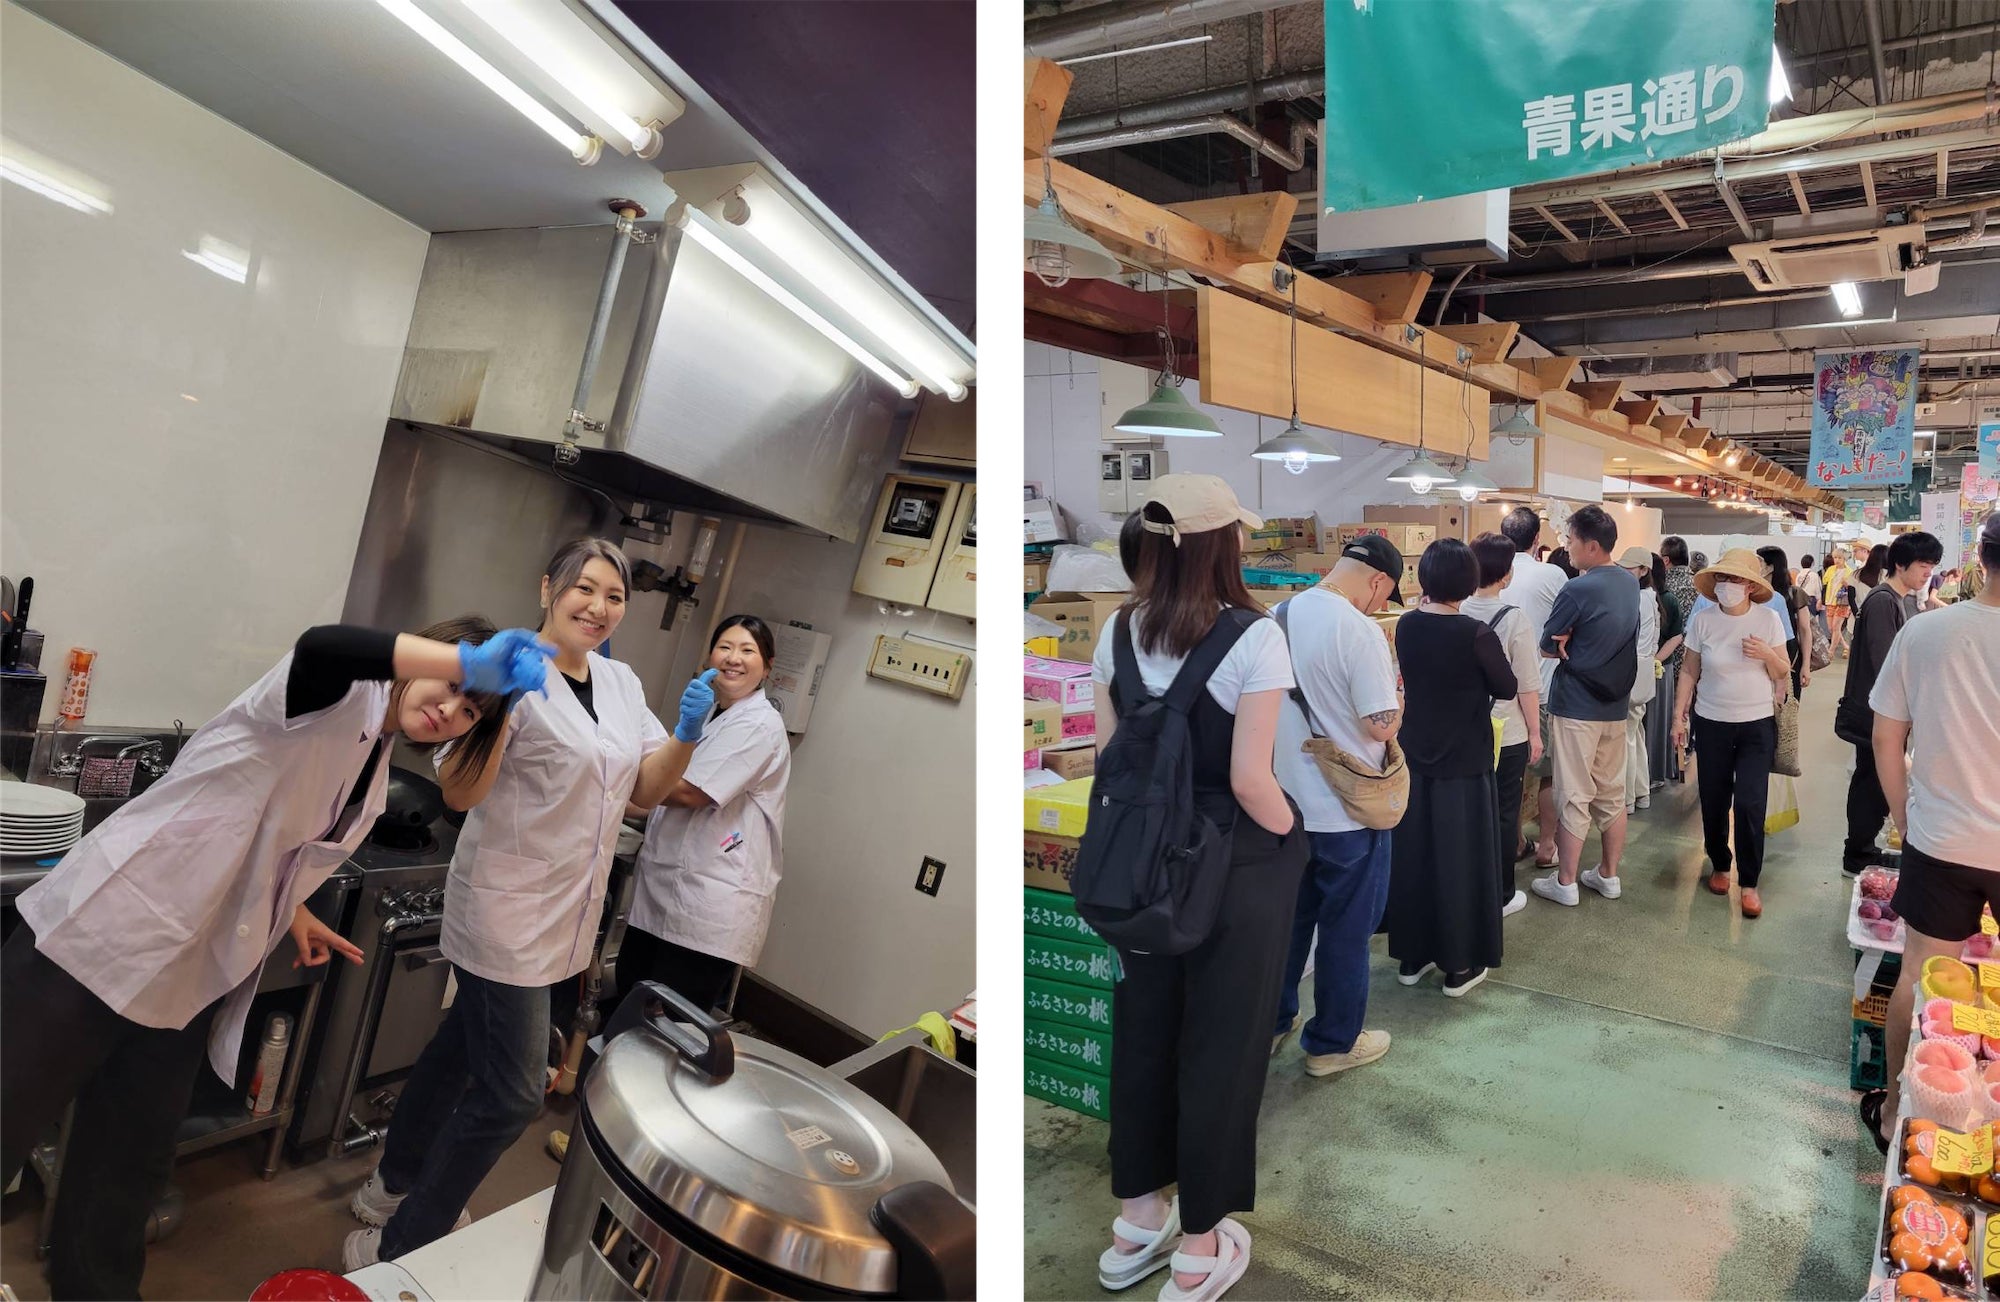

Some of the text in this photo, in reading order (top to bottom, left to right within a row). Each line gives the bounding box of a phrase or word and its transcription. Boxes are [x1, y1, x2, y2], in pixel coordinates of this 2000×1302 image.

[1522, 64, 1745, 161] 青果通り
[1027, 949, 1110, 981] ふるさとの桃
[1027, 991, 1110, 1025] ふるさとの桃
[1025, 1029, 1102, 1066] ふるさとの桃
[1027, 1071, 1101, 1110] ふるさとの桃
